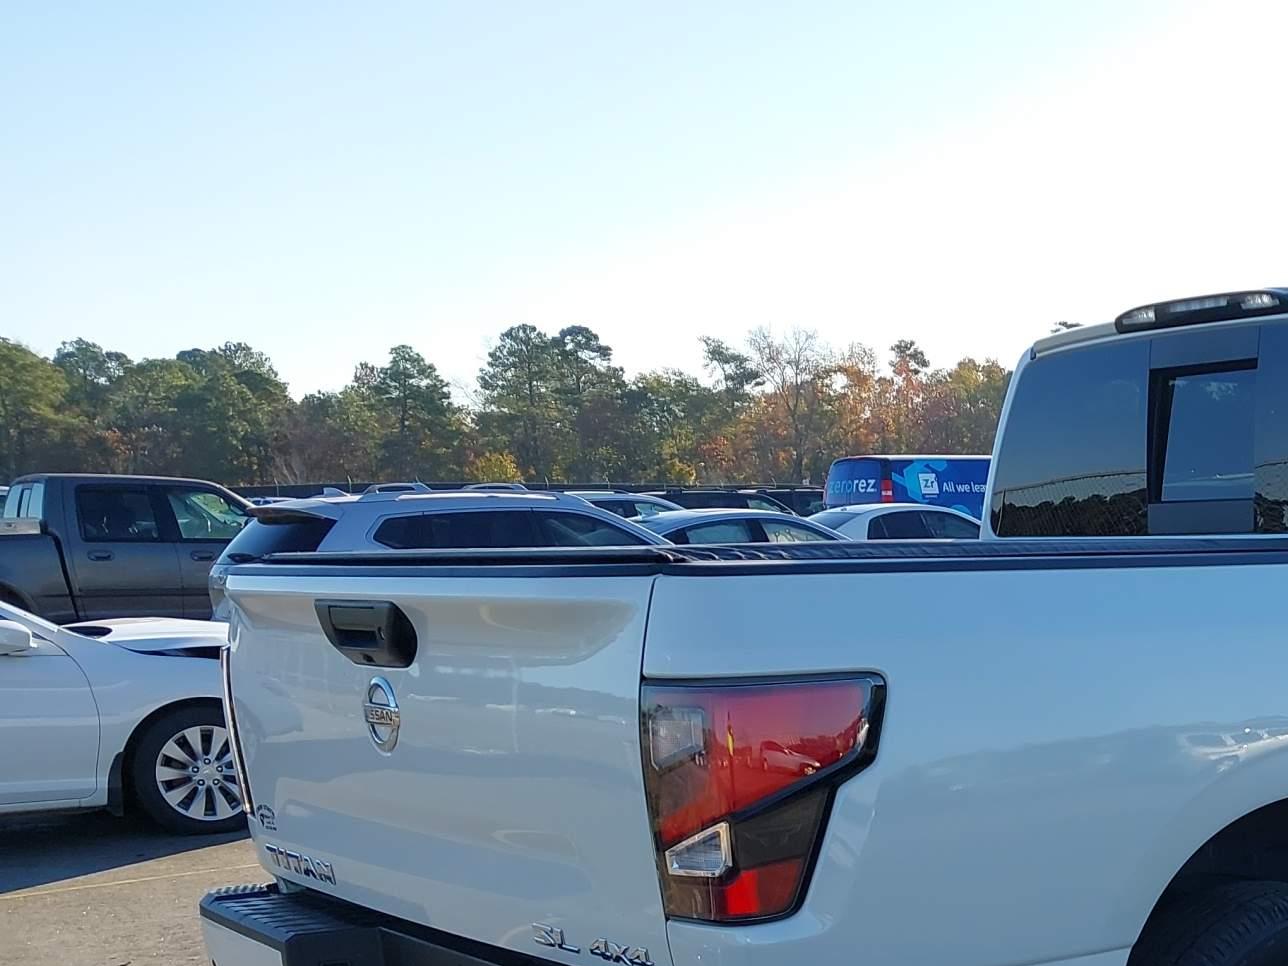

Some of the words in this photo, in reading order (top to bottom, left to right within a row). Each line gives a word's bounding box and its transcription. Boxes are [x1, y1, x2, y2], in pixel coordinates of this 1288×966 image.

[942, 481, 955, 493] All
[956, 484, 971, 493] we
[971, 481, 987, 493] lea
[265, 843, 337, 886] TITAN
[532, 922, 581, 954] SL
